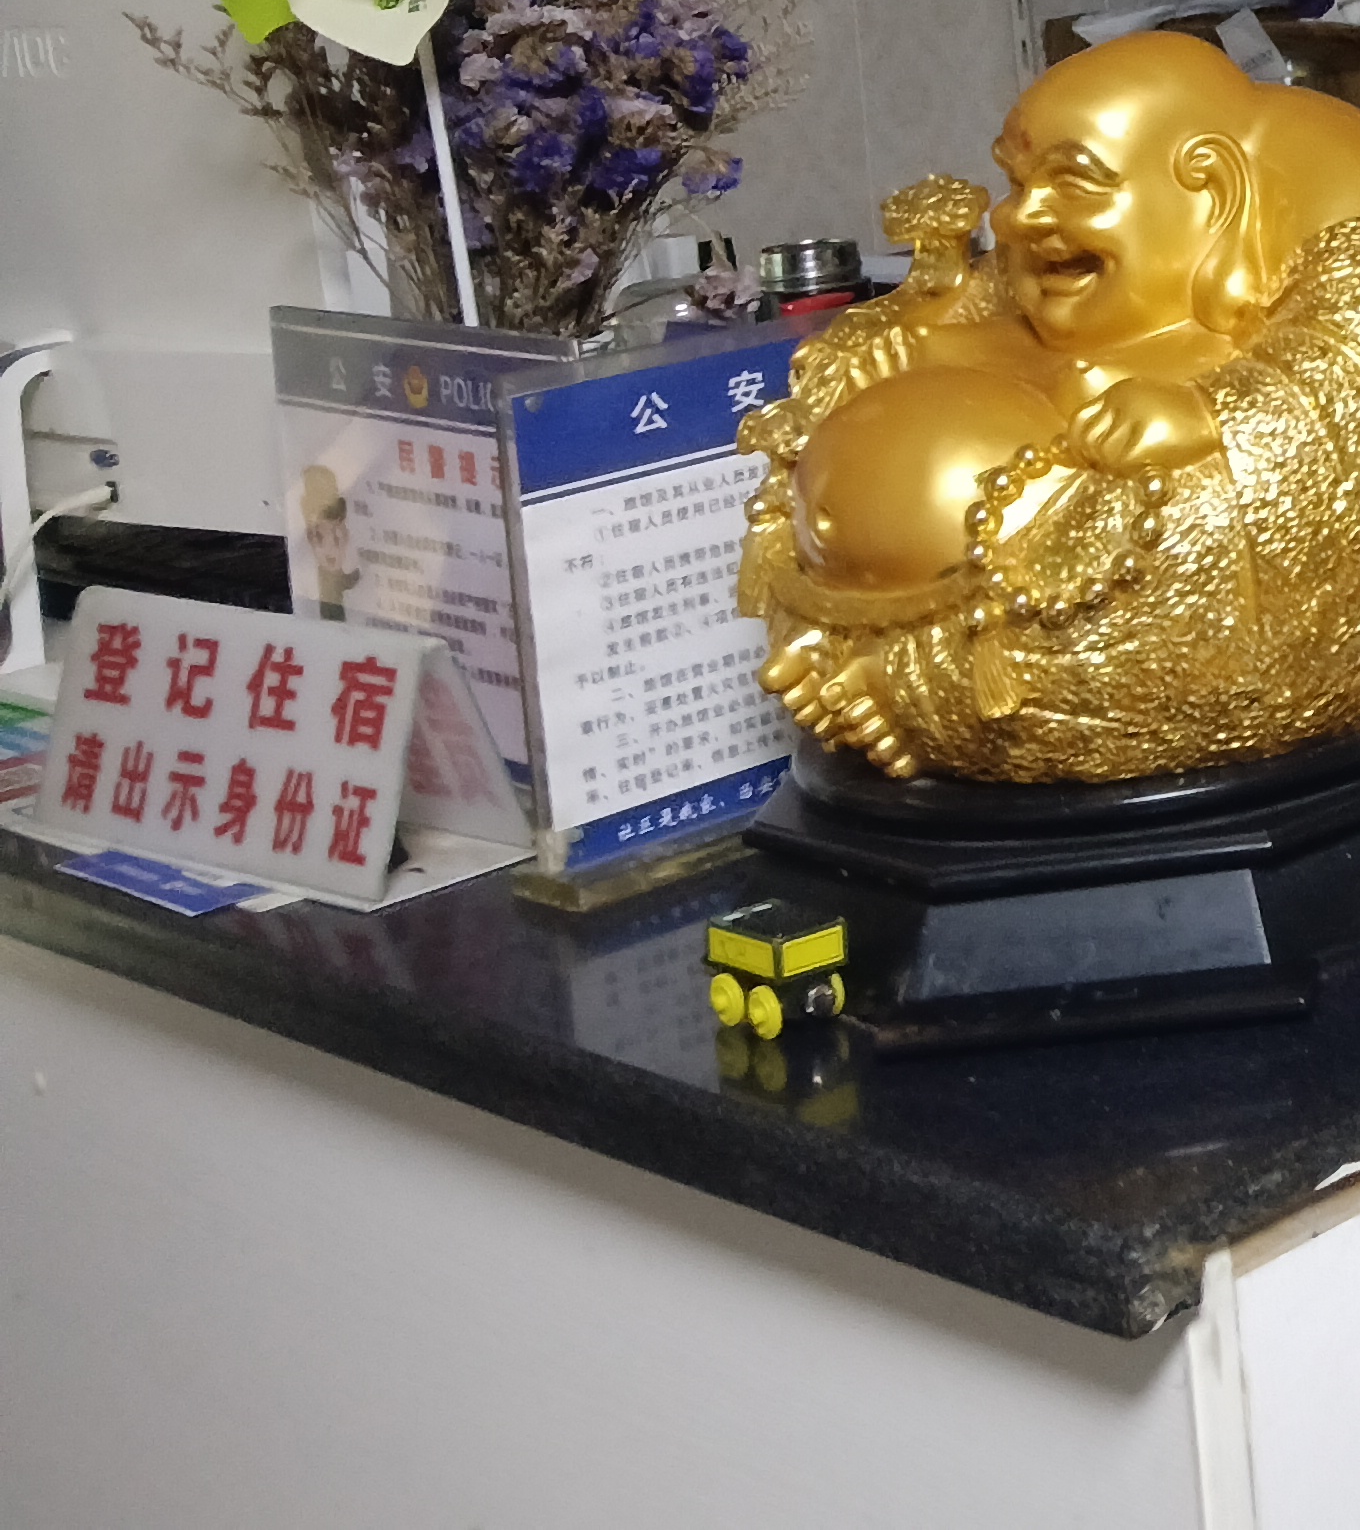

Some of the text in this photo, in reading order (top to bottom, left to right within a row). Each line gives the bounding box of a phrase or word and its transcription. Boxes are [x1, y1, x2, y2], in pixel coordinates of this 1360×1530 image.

[629, 369, 766, 436] 公安
[83, 622, 398, 753] 登记住宿
[61, 731, 379, 868] 请出示身份证
